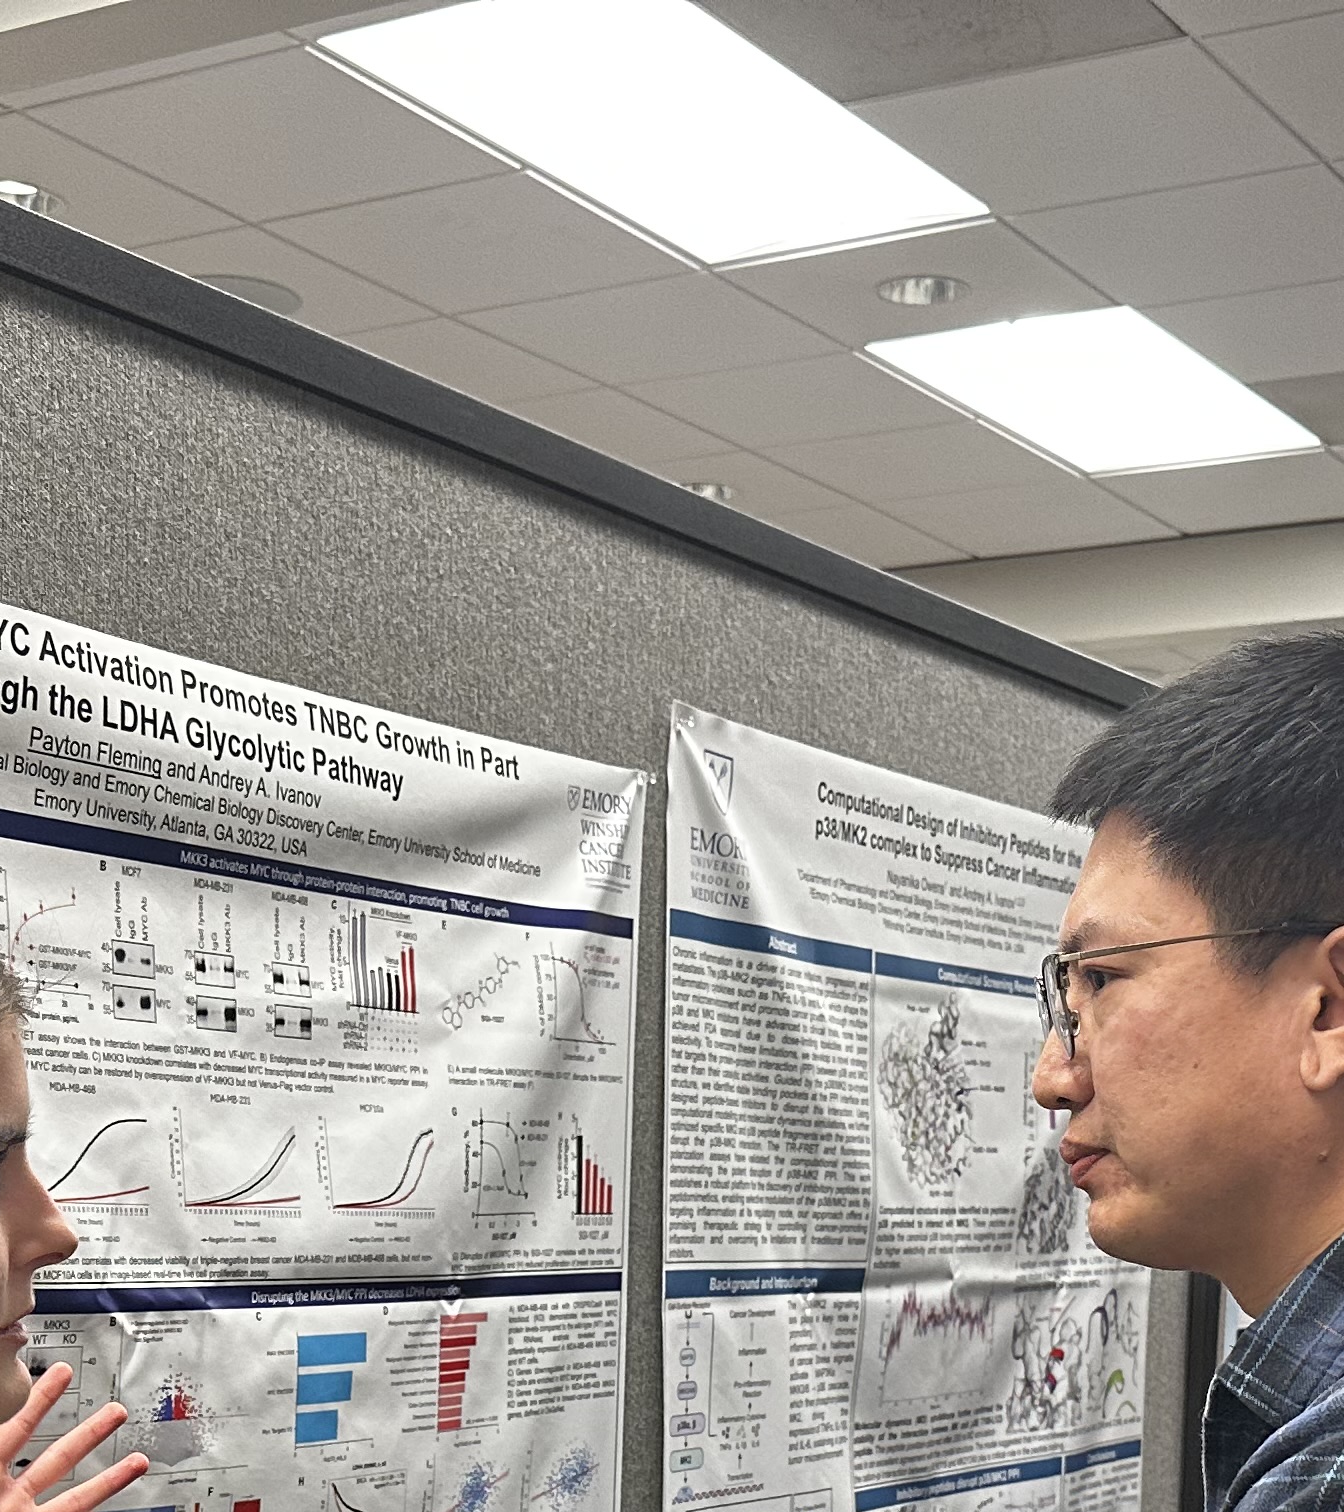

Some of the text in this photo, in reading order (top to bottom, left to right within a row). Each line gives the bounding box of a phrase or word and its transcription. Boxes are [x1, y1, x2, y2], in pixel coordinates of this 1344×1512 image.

[39, 631, 174, 695] Activation
[181, 669, 297, 726] Promotes
[304, 701, 368, 743] TNBC
[376, 721, 450, 765] Growth
[457, 741, 474, 770] in
[481, 747, 519, 780] Part
[49, 684, 92, 723] the
[103, 696, 179, 743] LDHA
[186, 717, 305, 773] Glycolytic
[313, 748, 404, 801] Pathway
[29, 726, 321, 809] Payton Fleming and Andrey A. Ivanov
[14, 756, 69, 786] Biology
[73, 770, 100, 789] and
[106, 778, 150, 803] Emory
[154, 785, 214, 814] Chemical
[218, 798, 263, 826] Biology
[266, 807, 324, 838] Discovery
[326, 821, 364, 844] Center,
[368, 830, 401, 852] Emory
[404, 837, 451, 863] University
[452, 845, 485, 866] School
[487, 854, 497, 869] of
[499, 857, 540, 877] Medicine
[582, 788, 631, 814] EMORY
[34, 788, 308, 858] Emory University, Atlanta, GA 30322, USA
[581, 819, 630, 841] WINSH
[818, 781, 904, 823] Computational
[907, 806, 944, 837] Design
[947, 818, 958, 837] of
[1010, 833, 1050, 861] Peptides
[1053, 844, 1066, 863] for
[579, 840, 624, 859] CANC
[691, 827, 747, 861] EMOR
[815, 816, 1076, 894] p38/MK2 complex to Suppress Cancer Inflammatio
[99, 860, 107, 871] B
[180, 850, 208, 868] MKK3
[209, 856, 249, 875] activates
[250, 864, 270, 878] MYC
[271, 869, 305, 888] through
[582, 859, 631, 879] INSTTE
[691, 885, 749, 909] MEDICINE
